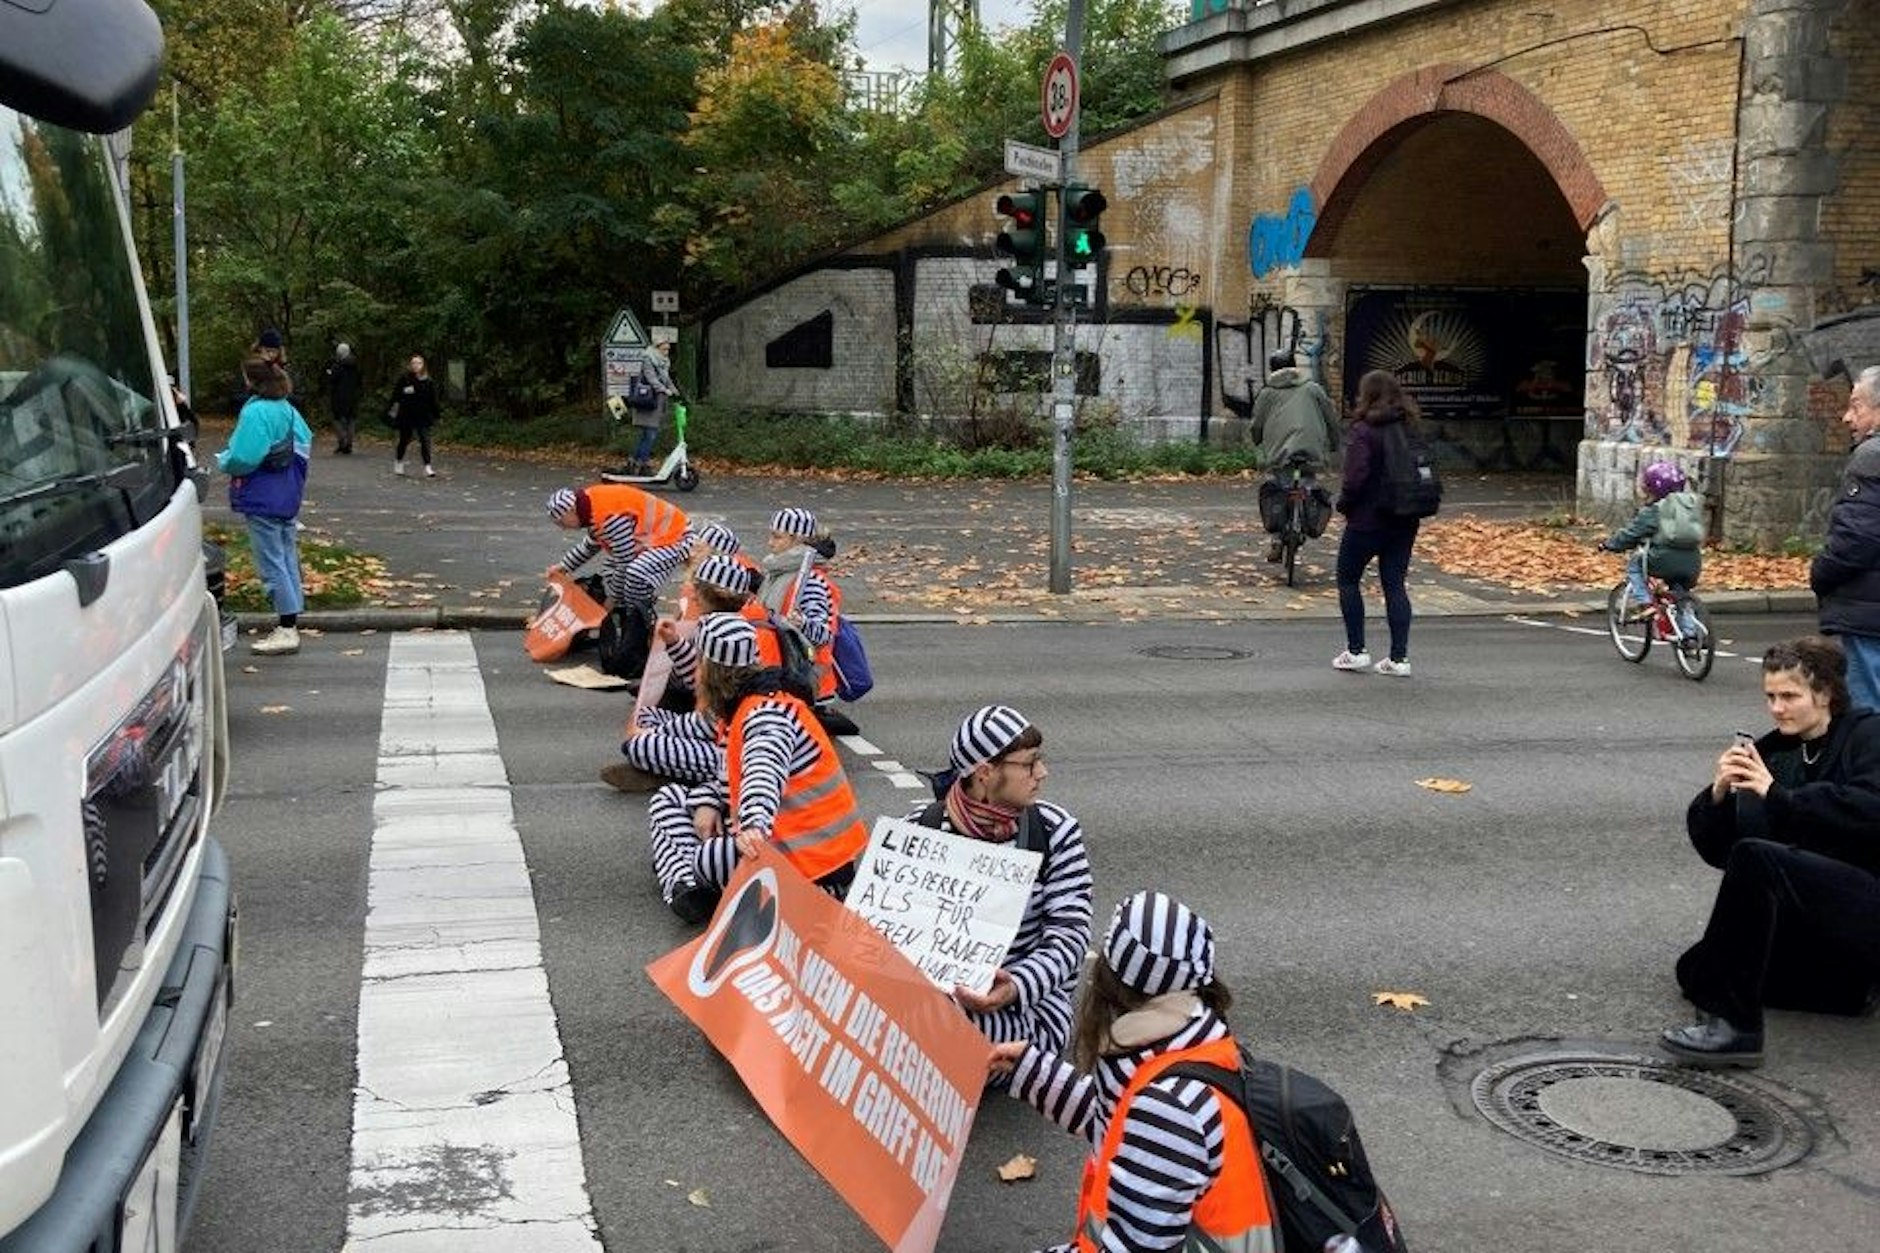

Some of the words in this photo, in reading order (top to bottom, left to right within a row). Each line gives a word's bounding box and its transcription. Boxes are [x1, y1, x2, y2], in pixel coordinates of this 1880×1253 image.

[881, 829, 949, 863] LIEBER
[859, 882, 913, 912] ALS
[873, 858, 989, 902] WEGSPERREN
[845, 991, 888, 1058] DIE
[731, 961, 792, 1014] DAS
[818, 1040, 864, 1106] IM
[853, 1070, 919, 1166] GRIFF
